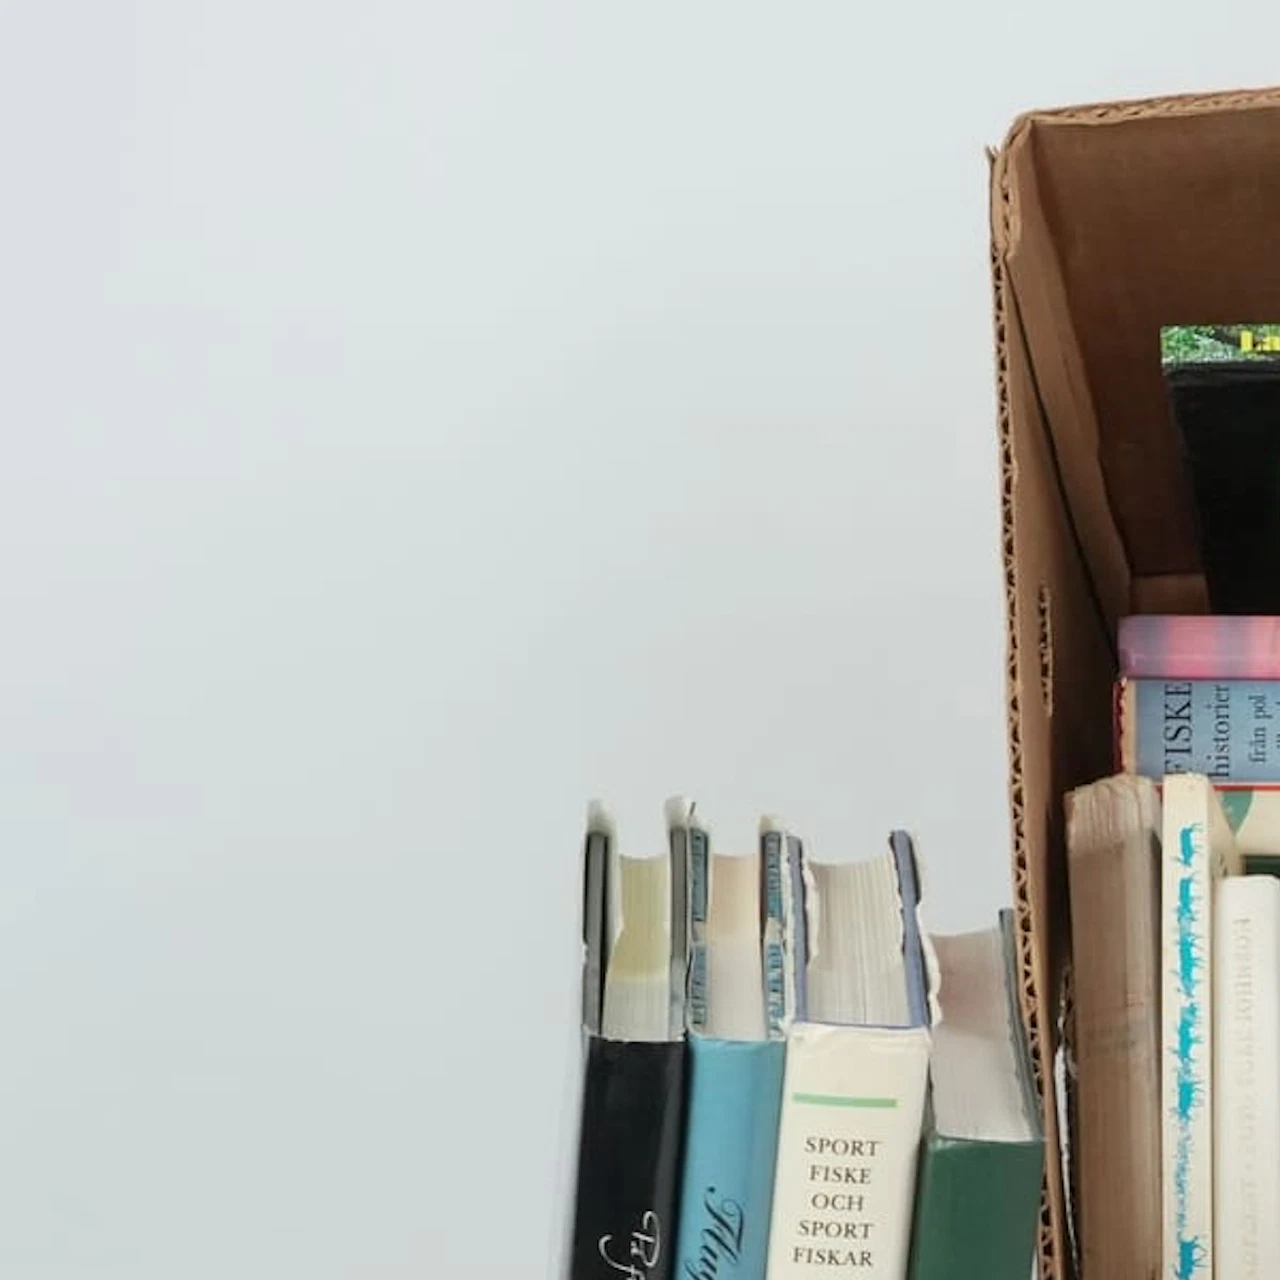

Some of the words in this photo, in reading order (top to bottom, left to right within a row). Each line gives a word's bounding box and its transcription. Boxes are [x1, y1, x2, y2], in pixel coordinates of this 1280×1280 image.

[1247, 694, 1274, 720] pol
[1205, 685, 1232, 779] historier
[1248, 727, 1267, 763] från
[803, 1137, 882, 1157] SPORT
[809, 1164, 872, 1185] FISKE
[811, 1192, 865, 1212] OCH
[797, 1219, 875, 1240] SPORT
[792, 1246, 874, 1267] FISKAR
